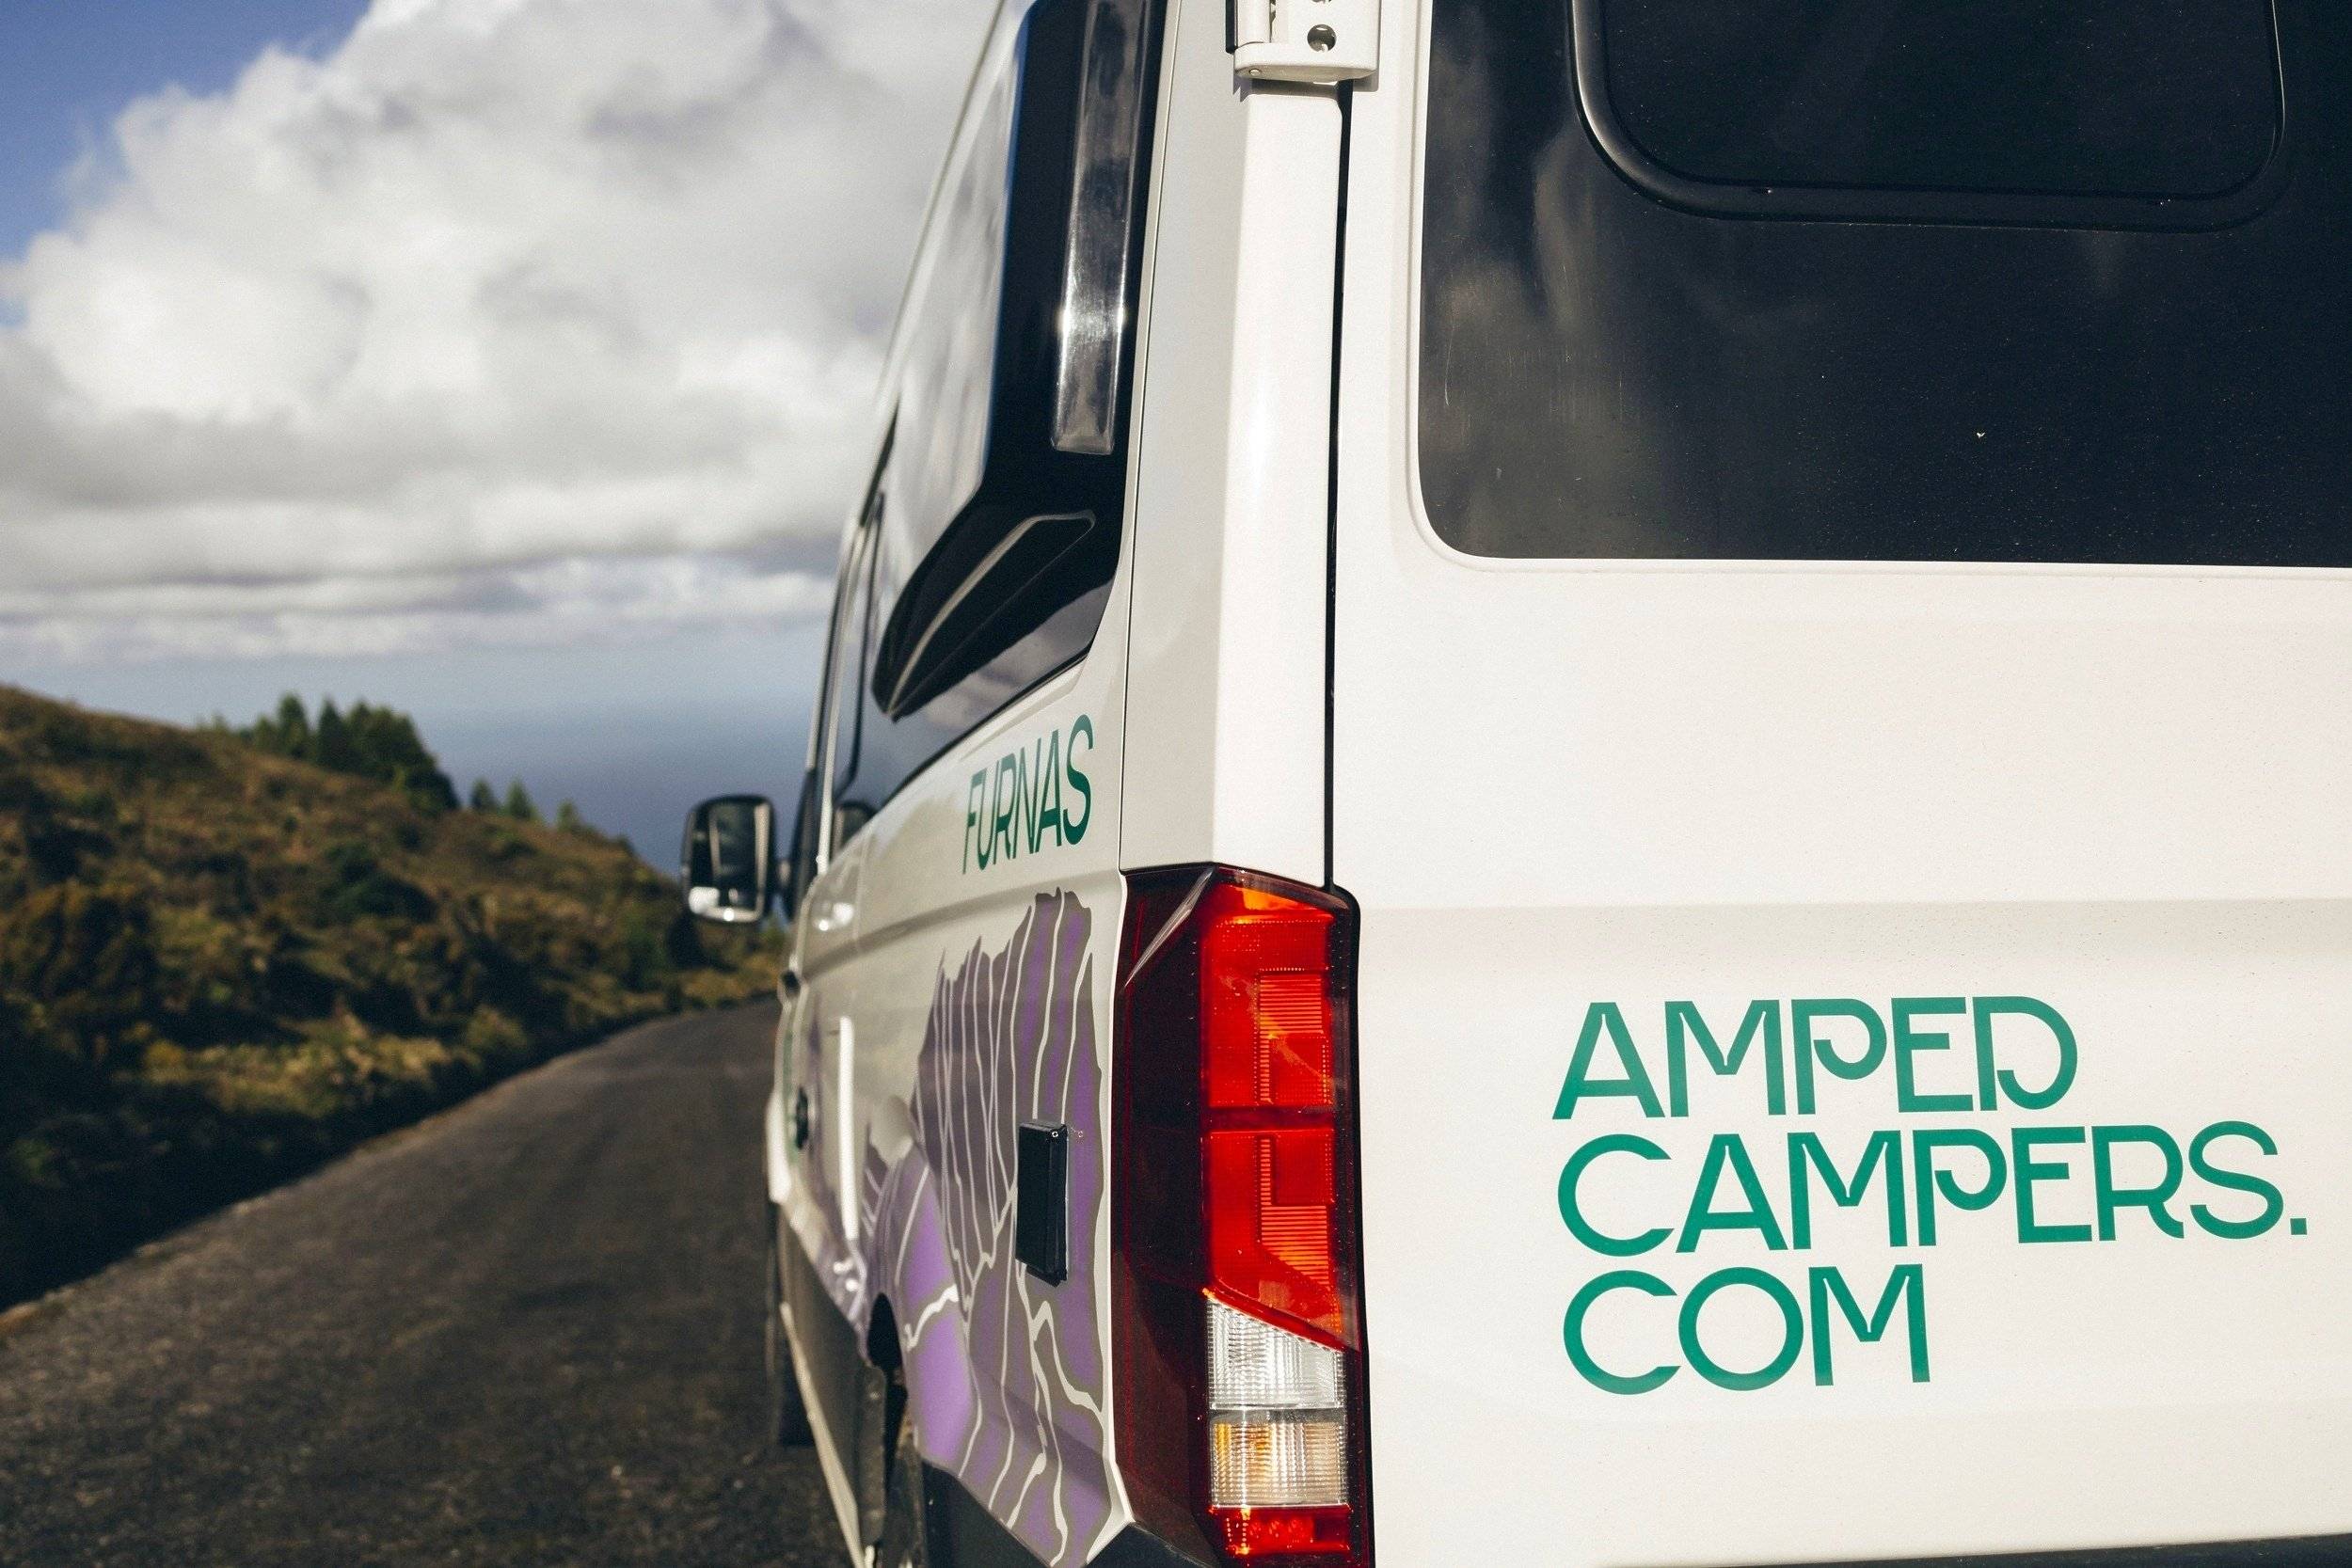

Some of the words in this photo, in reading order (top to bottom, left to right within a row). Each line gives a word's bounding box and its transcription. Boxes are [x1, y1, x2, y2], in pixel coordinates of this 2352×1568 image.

[961, 713, 1095, 875] FURNAS
[1552, 996, 2078, 1120] AMPED
[1557, 1121, 2308, 1257] CAMPERS.
[1563, 1264, 1931, 1395] COM
